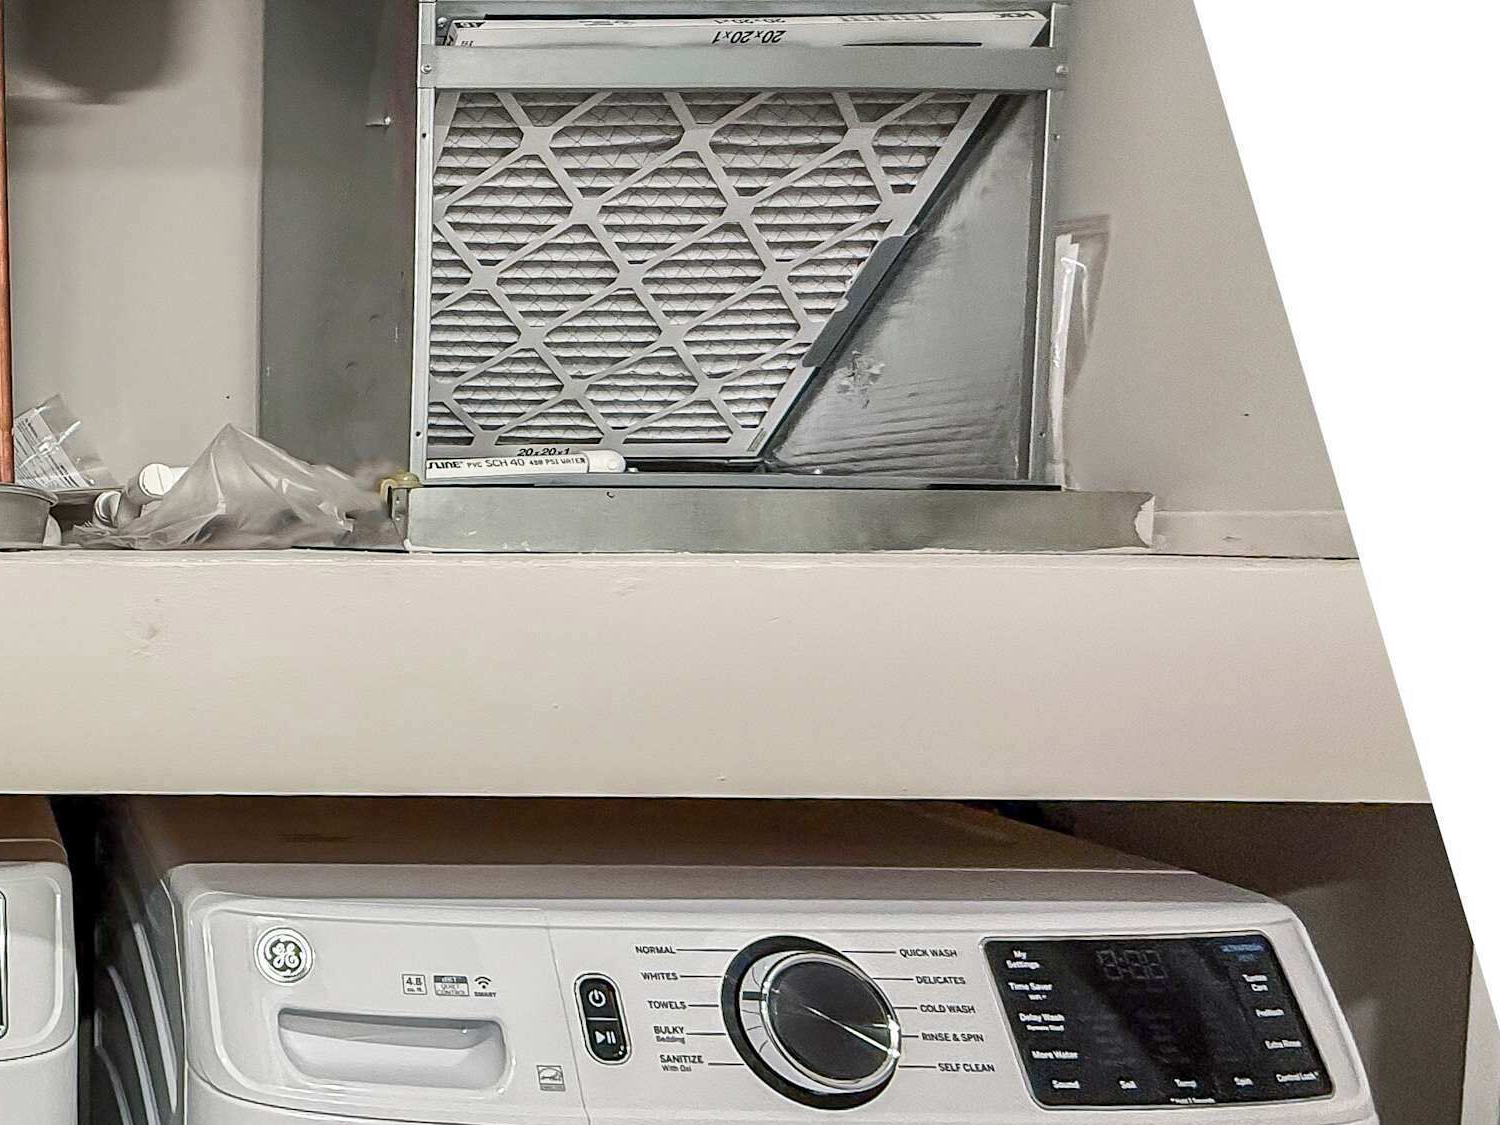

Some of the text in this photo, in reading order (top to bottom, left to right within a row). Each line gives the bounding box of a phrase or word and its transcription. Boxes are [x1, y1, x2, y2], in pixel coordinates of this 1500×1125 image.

[712, 30, 786, 44] 20x20x1
[484, 459, 508, 467] SCH
[510, 458, 525, 466] 40
[635, 946, 676, 954] NORMAL
[899, 949, 957, 958] QUICK WASH
[641, 972, 678, 980] WHITES
[915, 976, 966, 984] DELICATES
[648, 1001, 687, 1009] TOWELS
[920, 1004, 976, 1013] COLD WASH
[654, 1026, 684, 1034] BULKY
[921, 1032, 984, 1042] RINSE & SPIN
[660, 1055, 704, 1064] SANITIZE
[938, 1063, 995, 1072] SELF CLEAN
